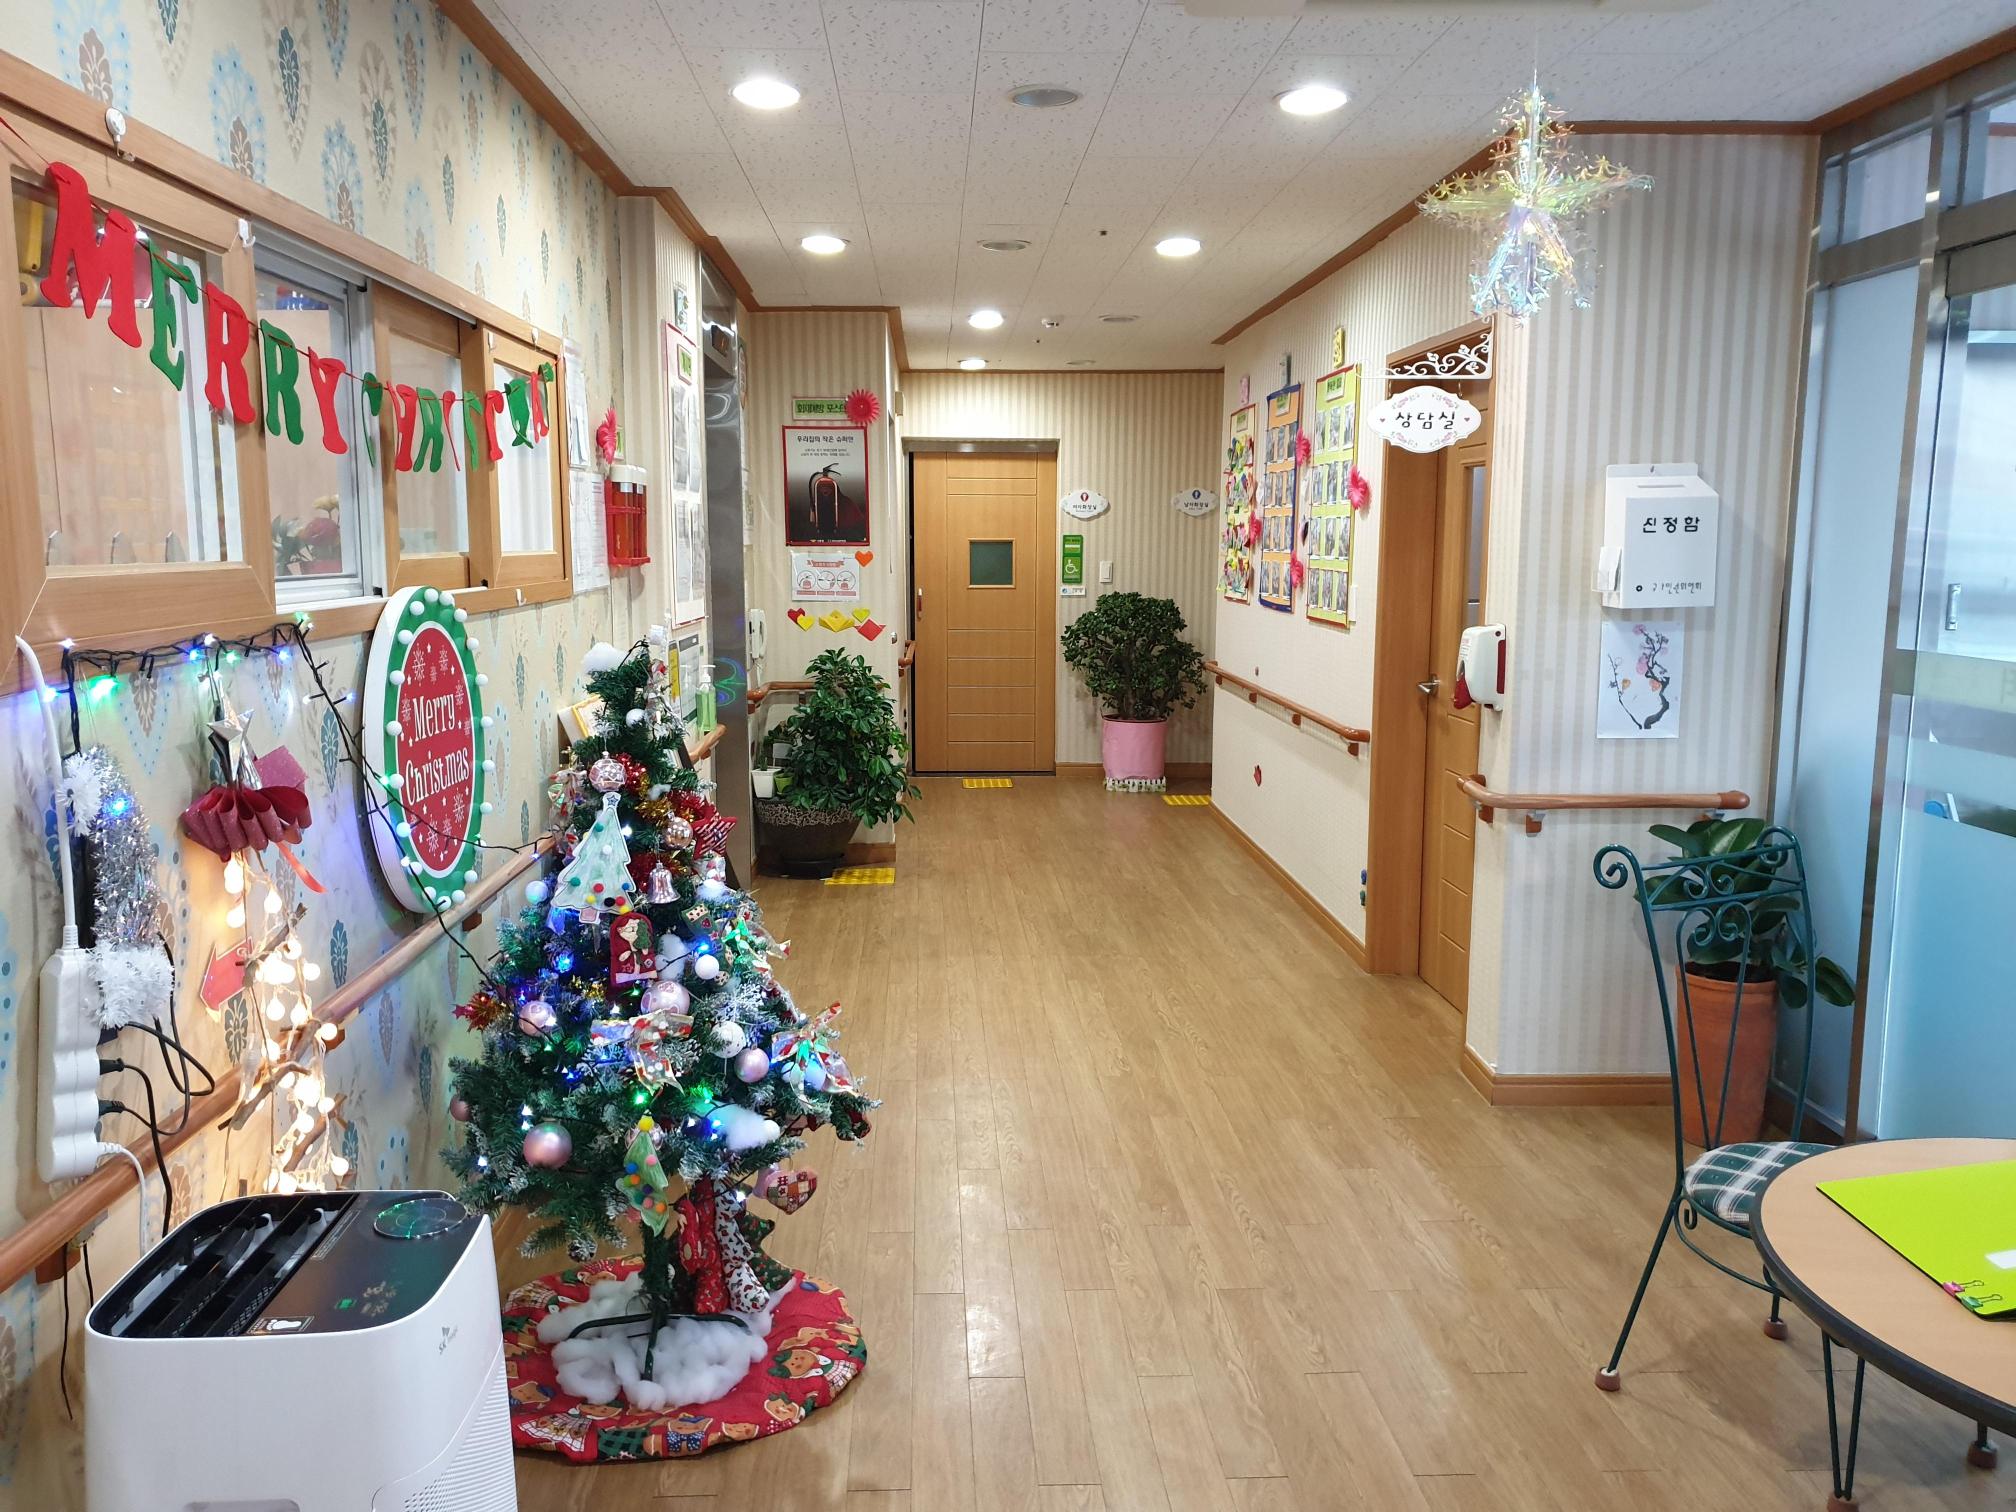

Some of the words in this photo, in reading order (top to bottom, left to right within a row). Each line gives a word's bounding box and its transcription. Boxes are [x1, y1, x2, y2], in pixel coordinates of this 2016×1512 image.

[40, 161, 348, 454] MERRY
[1395, 411, 1455, 430] 상담실
[412, 693, 456, 742] Merry
[405, 747, 470, 806] Christmas
